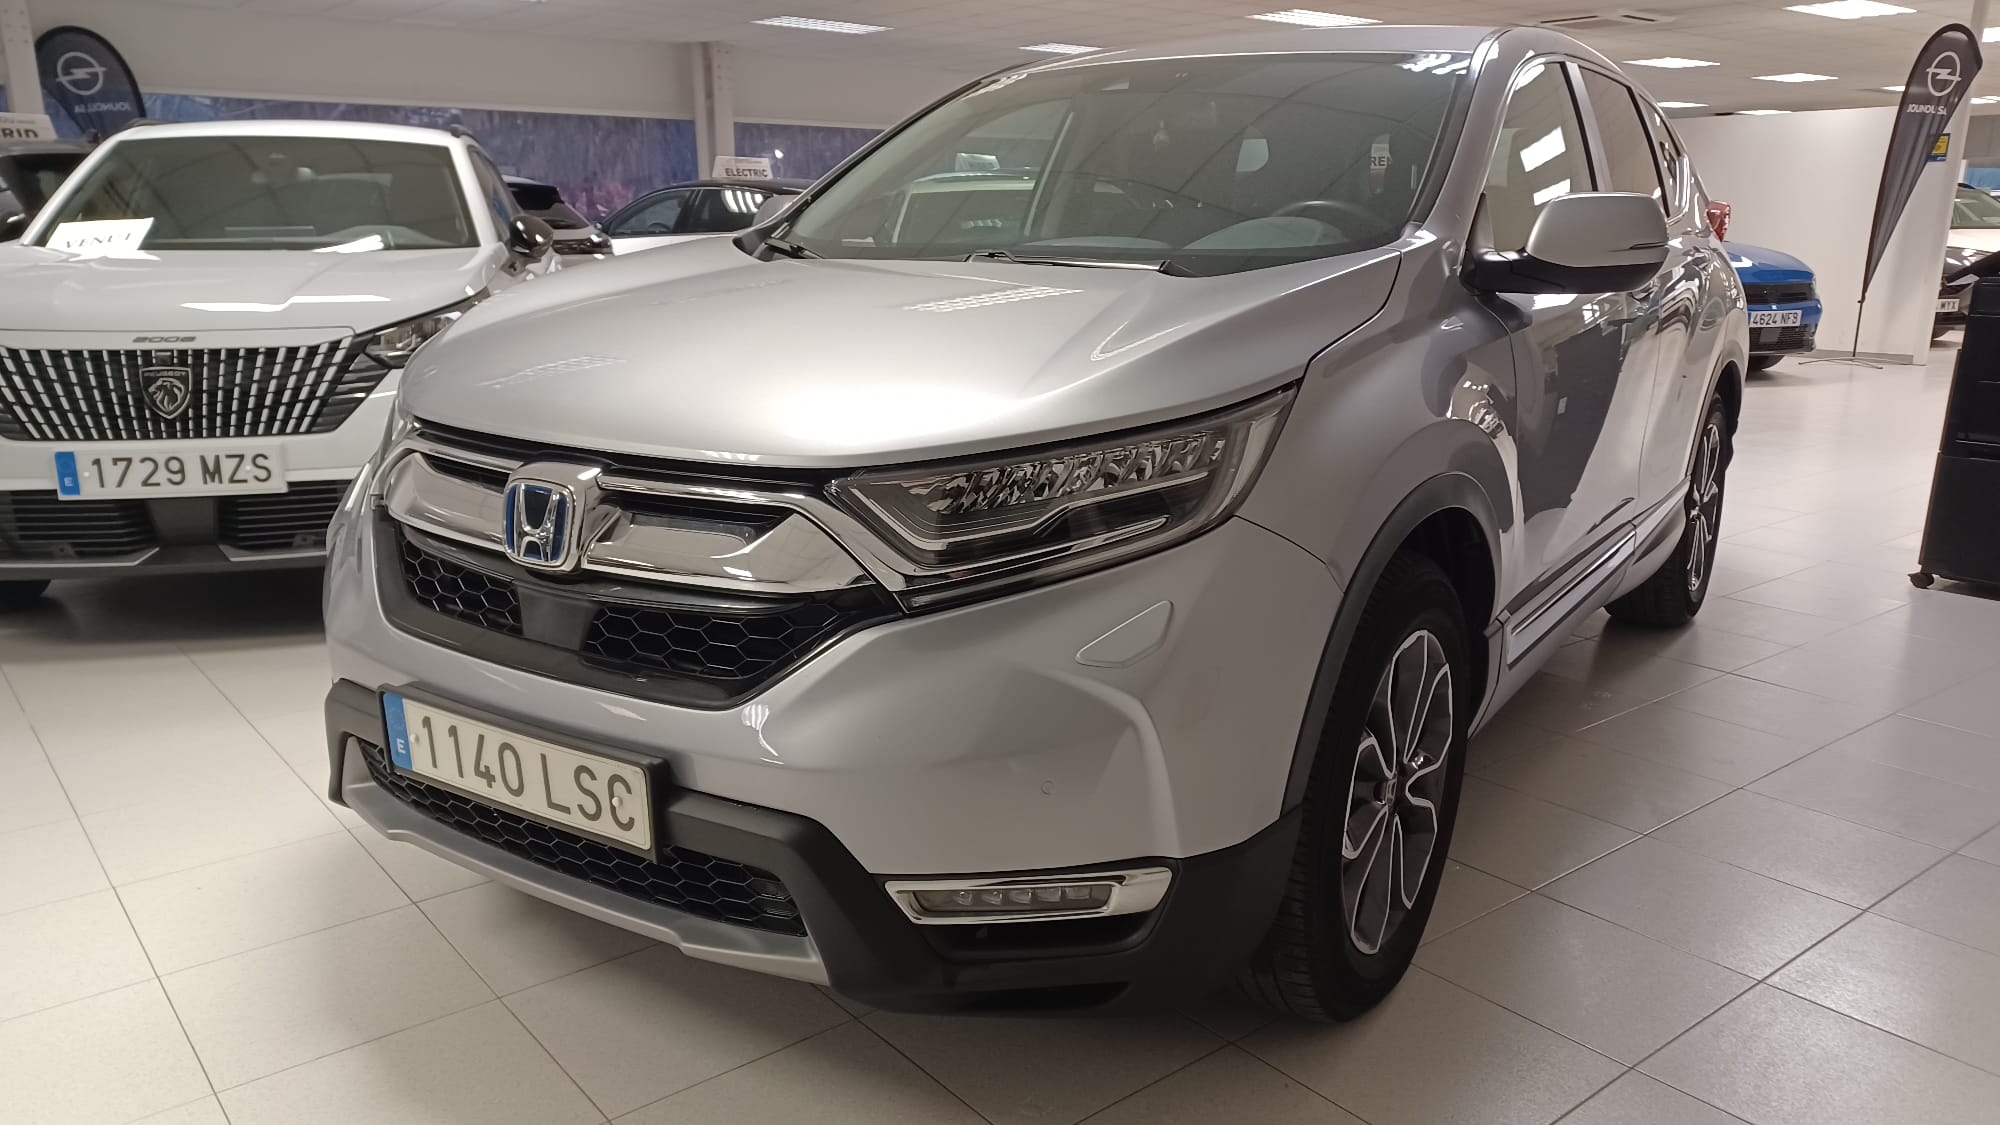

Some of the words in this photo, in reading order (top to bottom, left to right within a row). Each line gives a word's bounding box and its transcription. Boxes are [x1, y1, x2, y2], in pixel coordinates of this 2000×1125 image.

[724, 167, 769, 178] ELECTRIC
[1752, 312, 1778, 326] 4624
[132, 335, 197, 343] 2008
[63, 477, 74, 487] E
[91, 455, 186, 489] 1729
[199, 453, 272, 485] MZS
[396, 738, 406, 755] E
[421, 715, 525, 798] 1140
[540, 752, 635, 832] LSC
